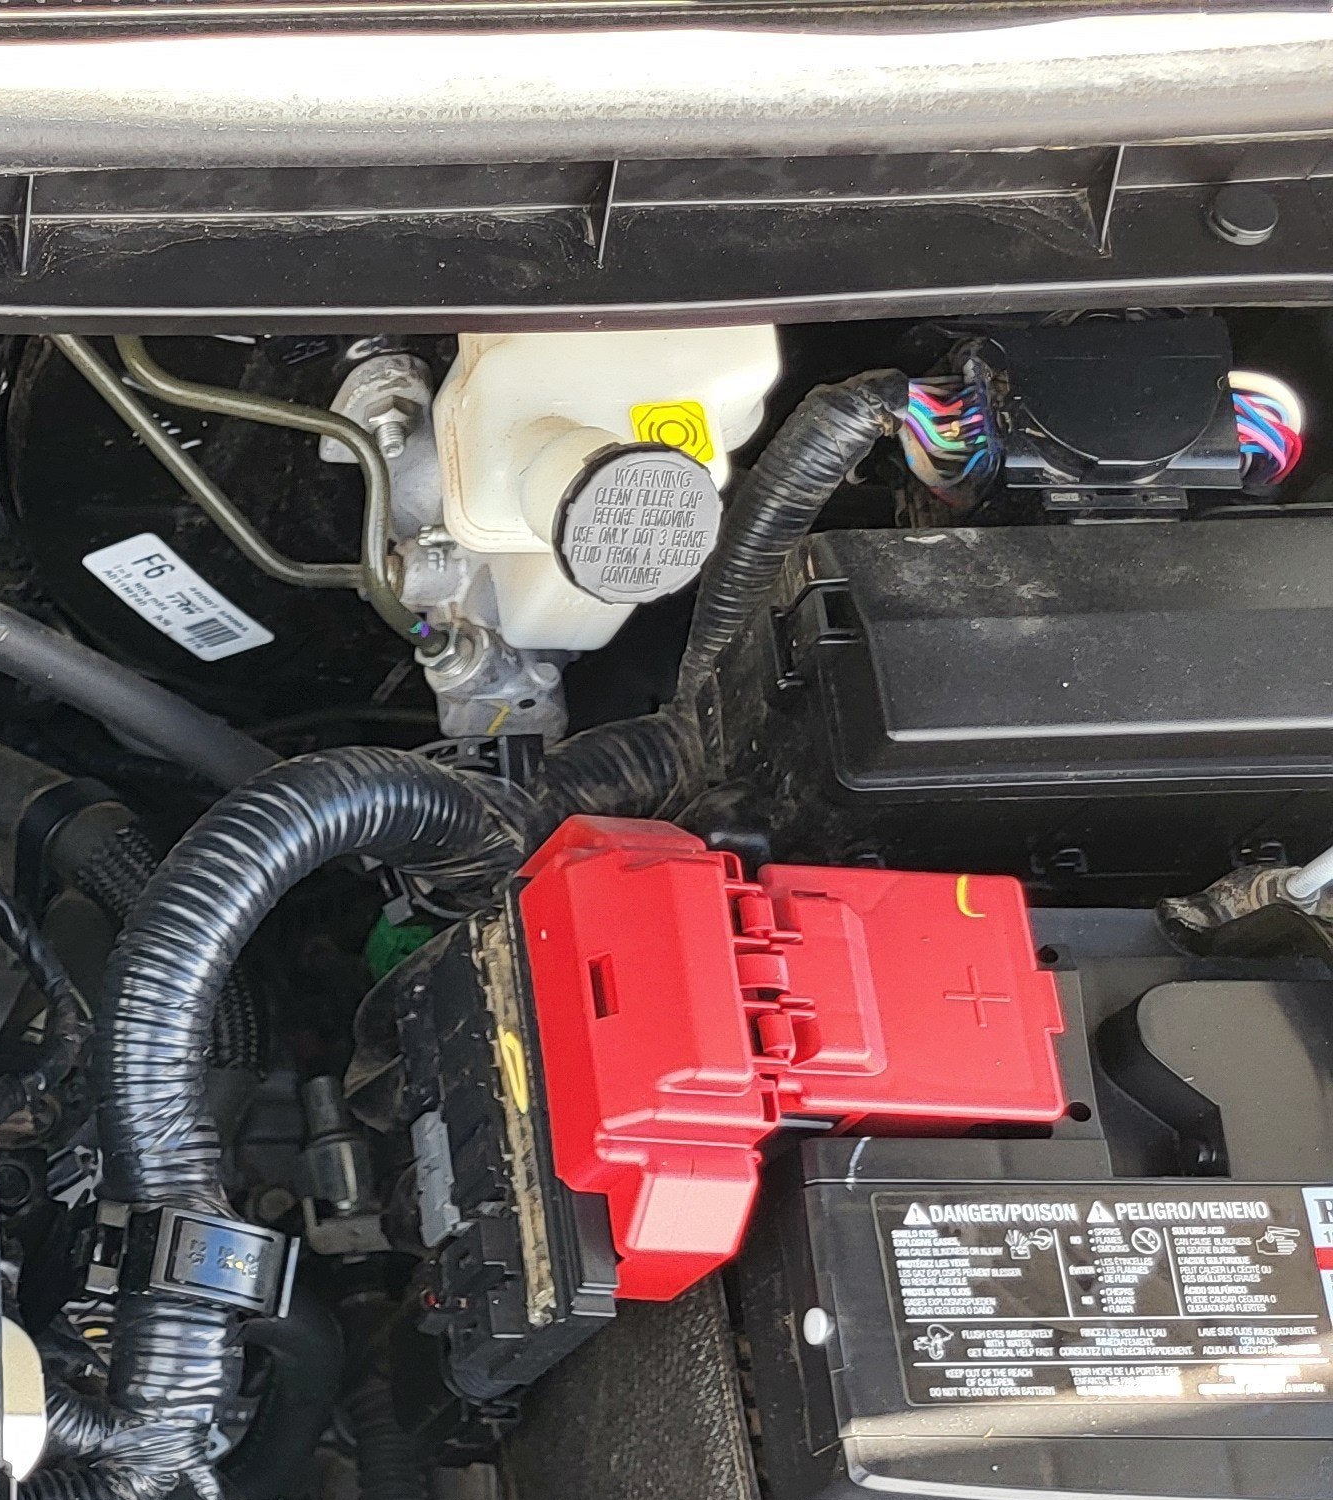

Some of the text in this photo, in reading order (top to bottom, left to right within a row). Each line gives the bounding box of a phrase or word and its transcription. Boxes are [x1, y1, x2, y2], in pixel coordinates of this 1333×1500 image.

[615, 467, 693, 488] WARNING
[595, 487, 703, 509] CLEAN FILLER CAP
[593, 507, 696, 527] BEFORE REMOVING
[573, 526, 709, 548] USE ONLY DOT 3 BRAKE
[131, 553, 175, 579] F6
[571, 545, 700, 567] FLUID FROM A SEALED
[601, 566, 662, 585] CONTAINER
[929, 1203, 1079, 1222] DANGER/POISON
[1115, 1201, 1270, 1221] PELIGRO/VENENO
